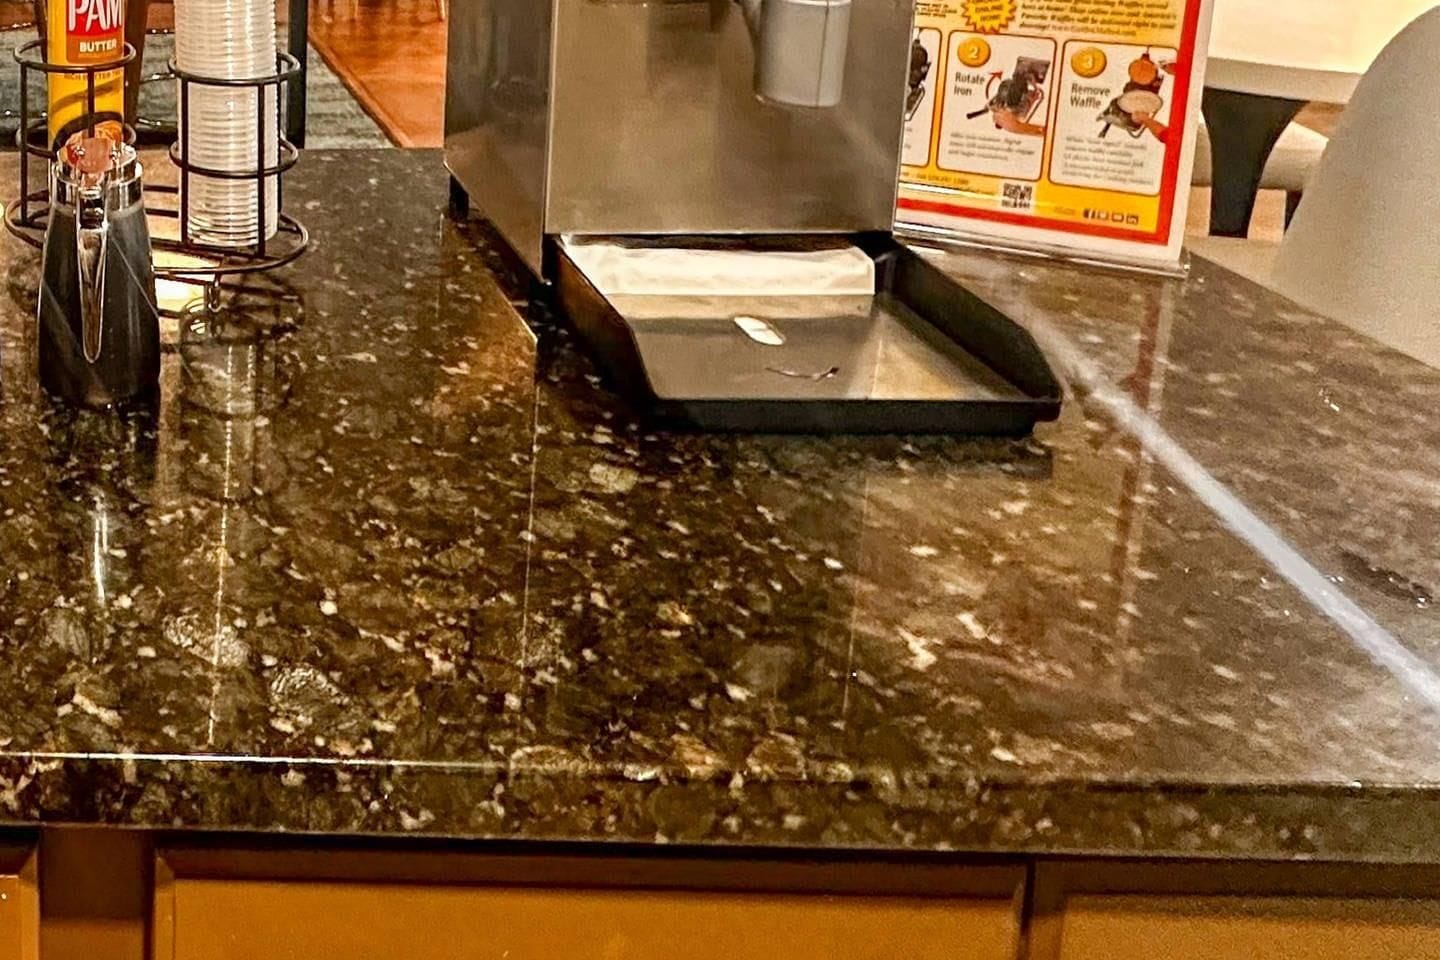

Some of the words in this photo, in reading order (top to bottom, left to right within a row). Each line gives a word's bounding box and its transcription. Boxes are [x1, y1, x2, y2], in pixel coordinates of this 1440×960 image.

[79, 38, 117, 52] BUTTER
[968, 46, 979, 59] 2
[1083, 56, 1094, 69] 3
[955, 71, 986, 86] Rotate
[954, 85, 973, 97] Iron
[1071, 83, 1111, 98] Remove
[1070, 95, 1102, 108] Waffle
